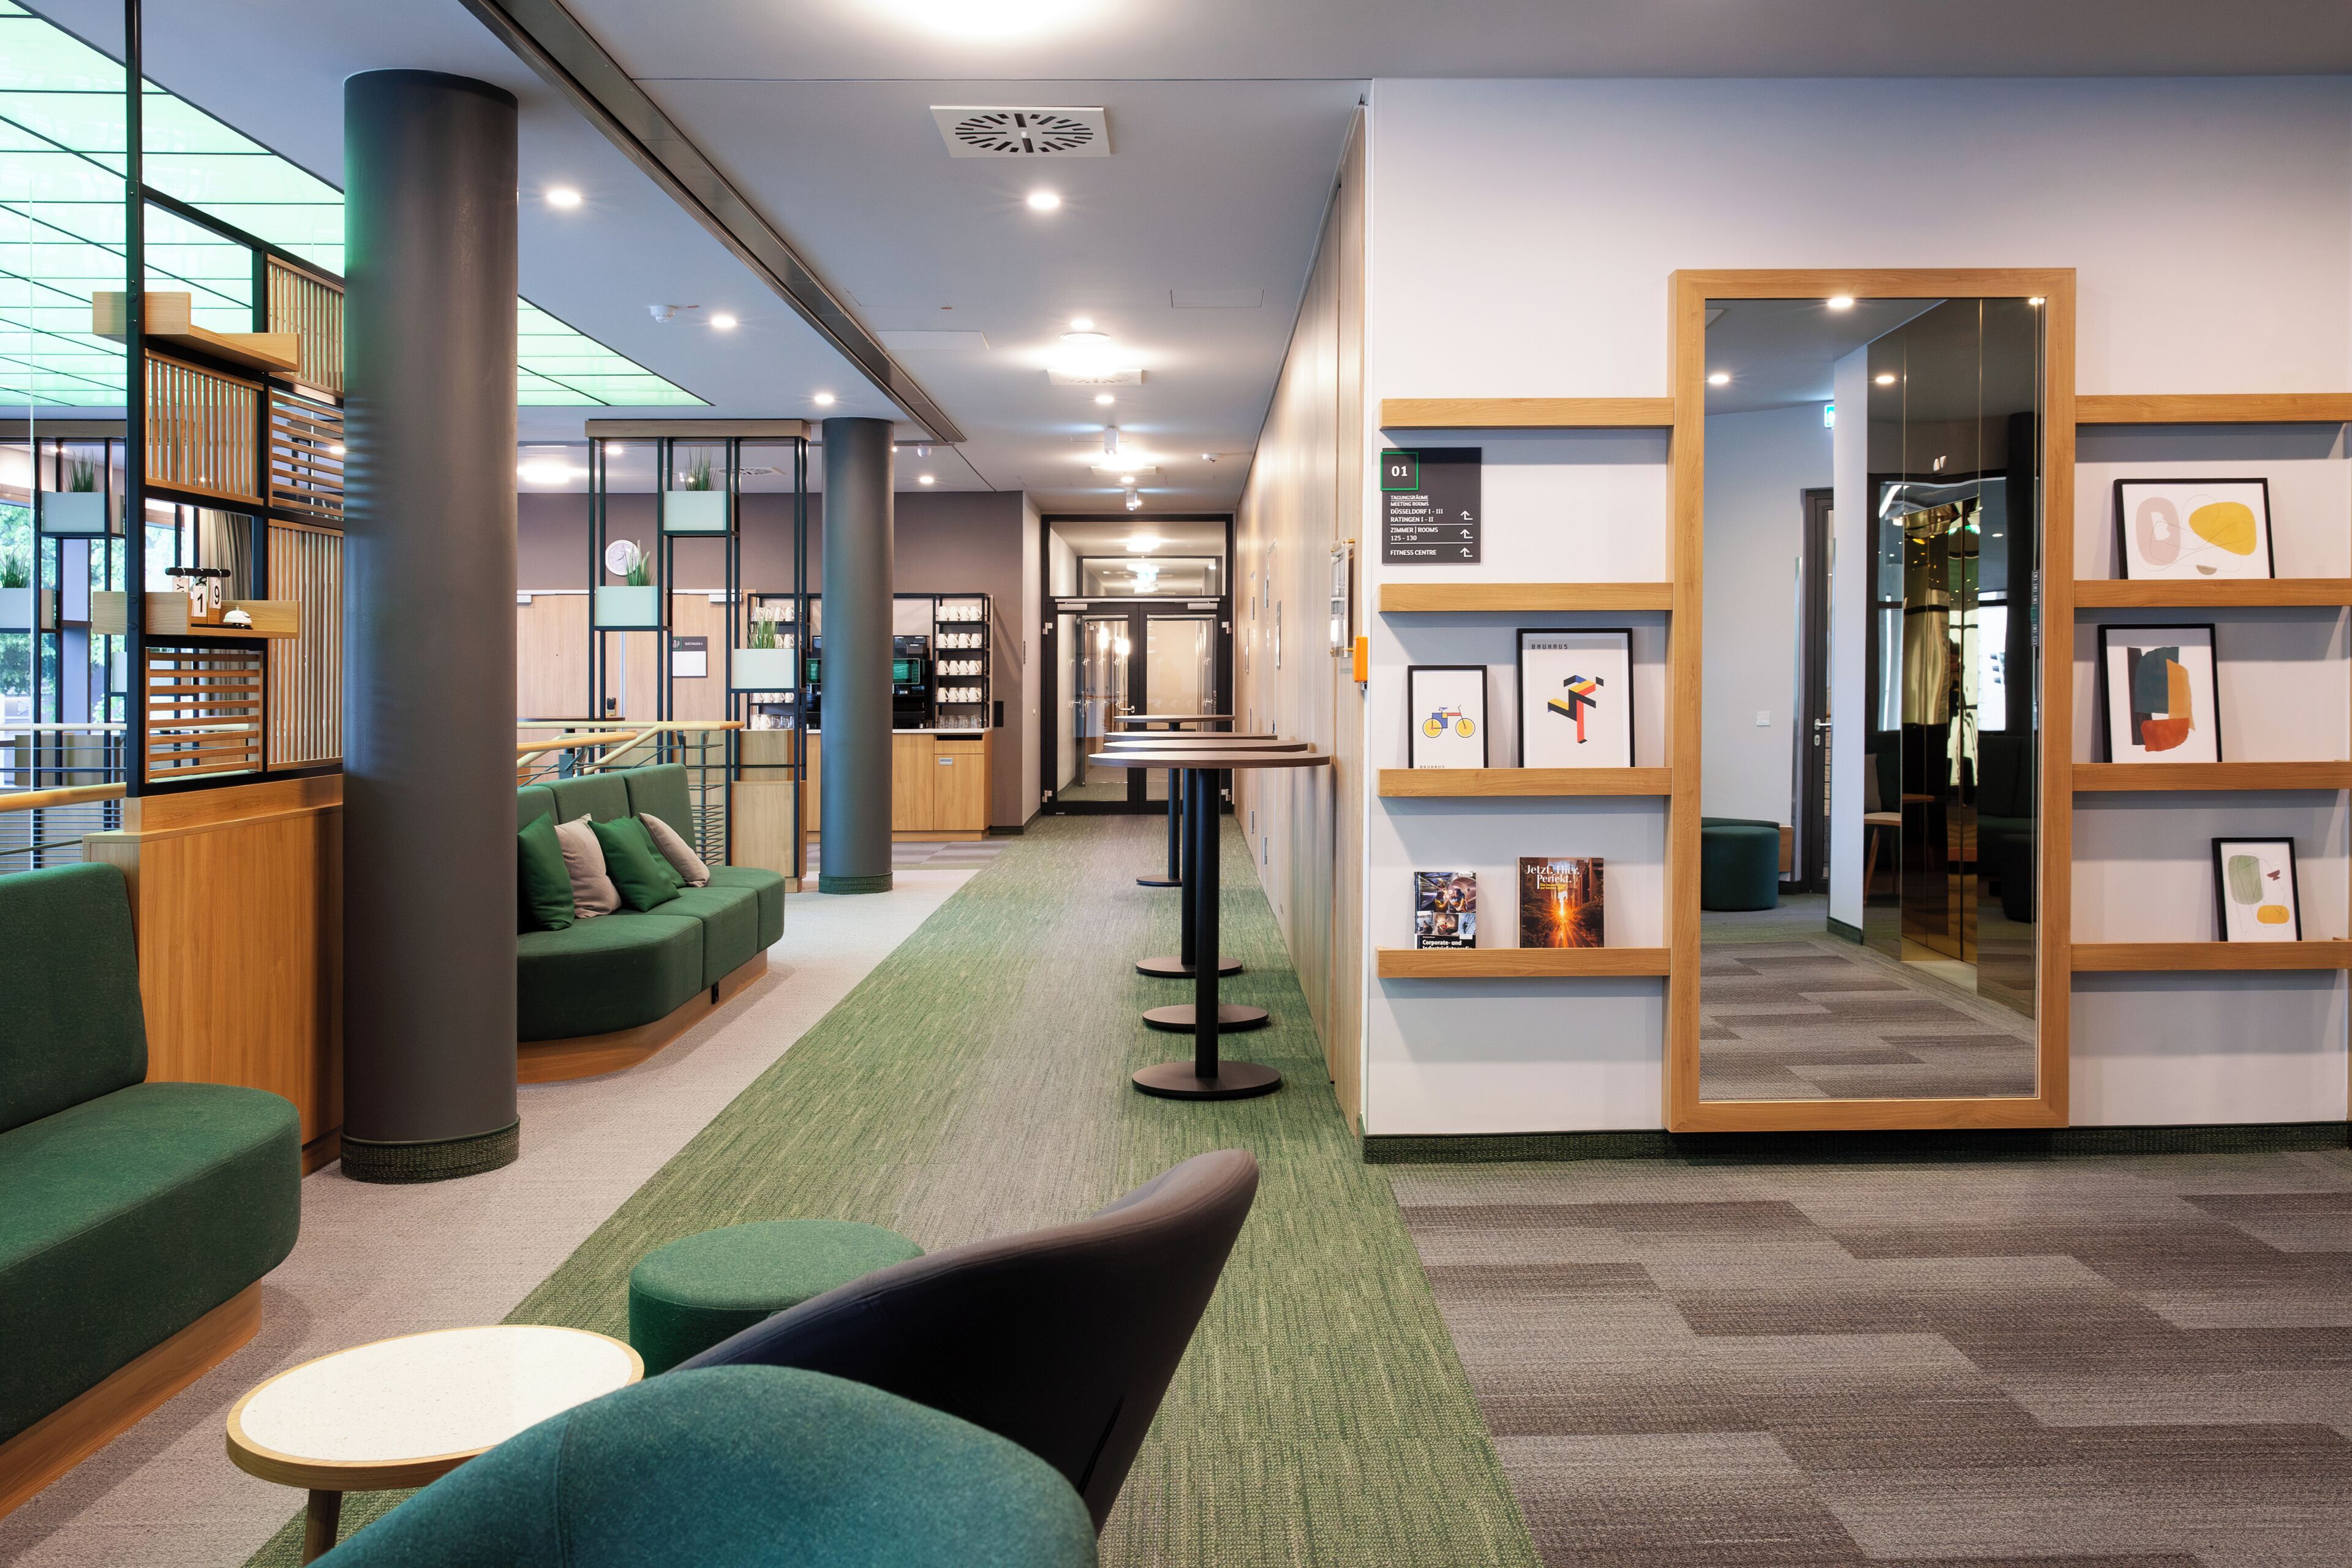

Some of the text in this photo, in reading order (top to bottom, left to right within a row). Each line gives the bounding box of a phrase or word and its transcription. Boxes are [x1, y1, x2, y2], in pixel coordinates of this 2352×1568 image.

[1391, 466, 1408, 477] 01
[1524, 865, 1580, 875] Jetzt. Hier.
[1537, 874, 1572, 889] Perfekt.
